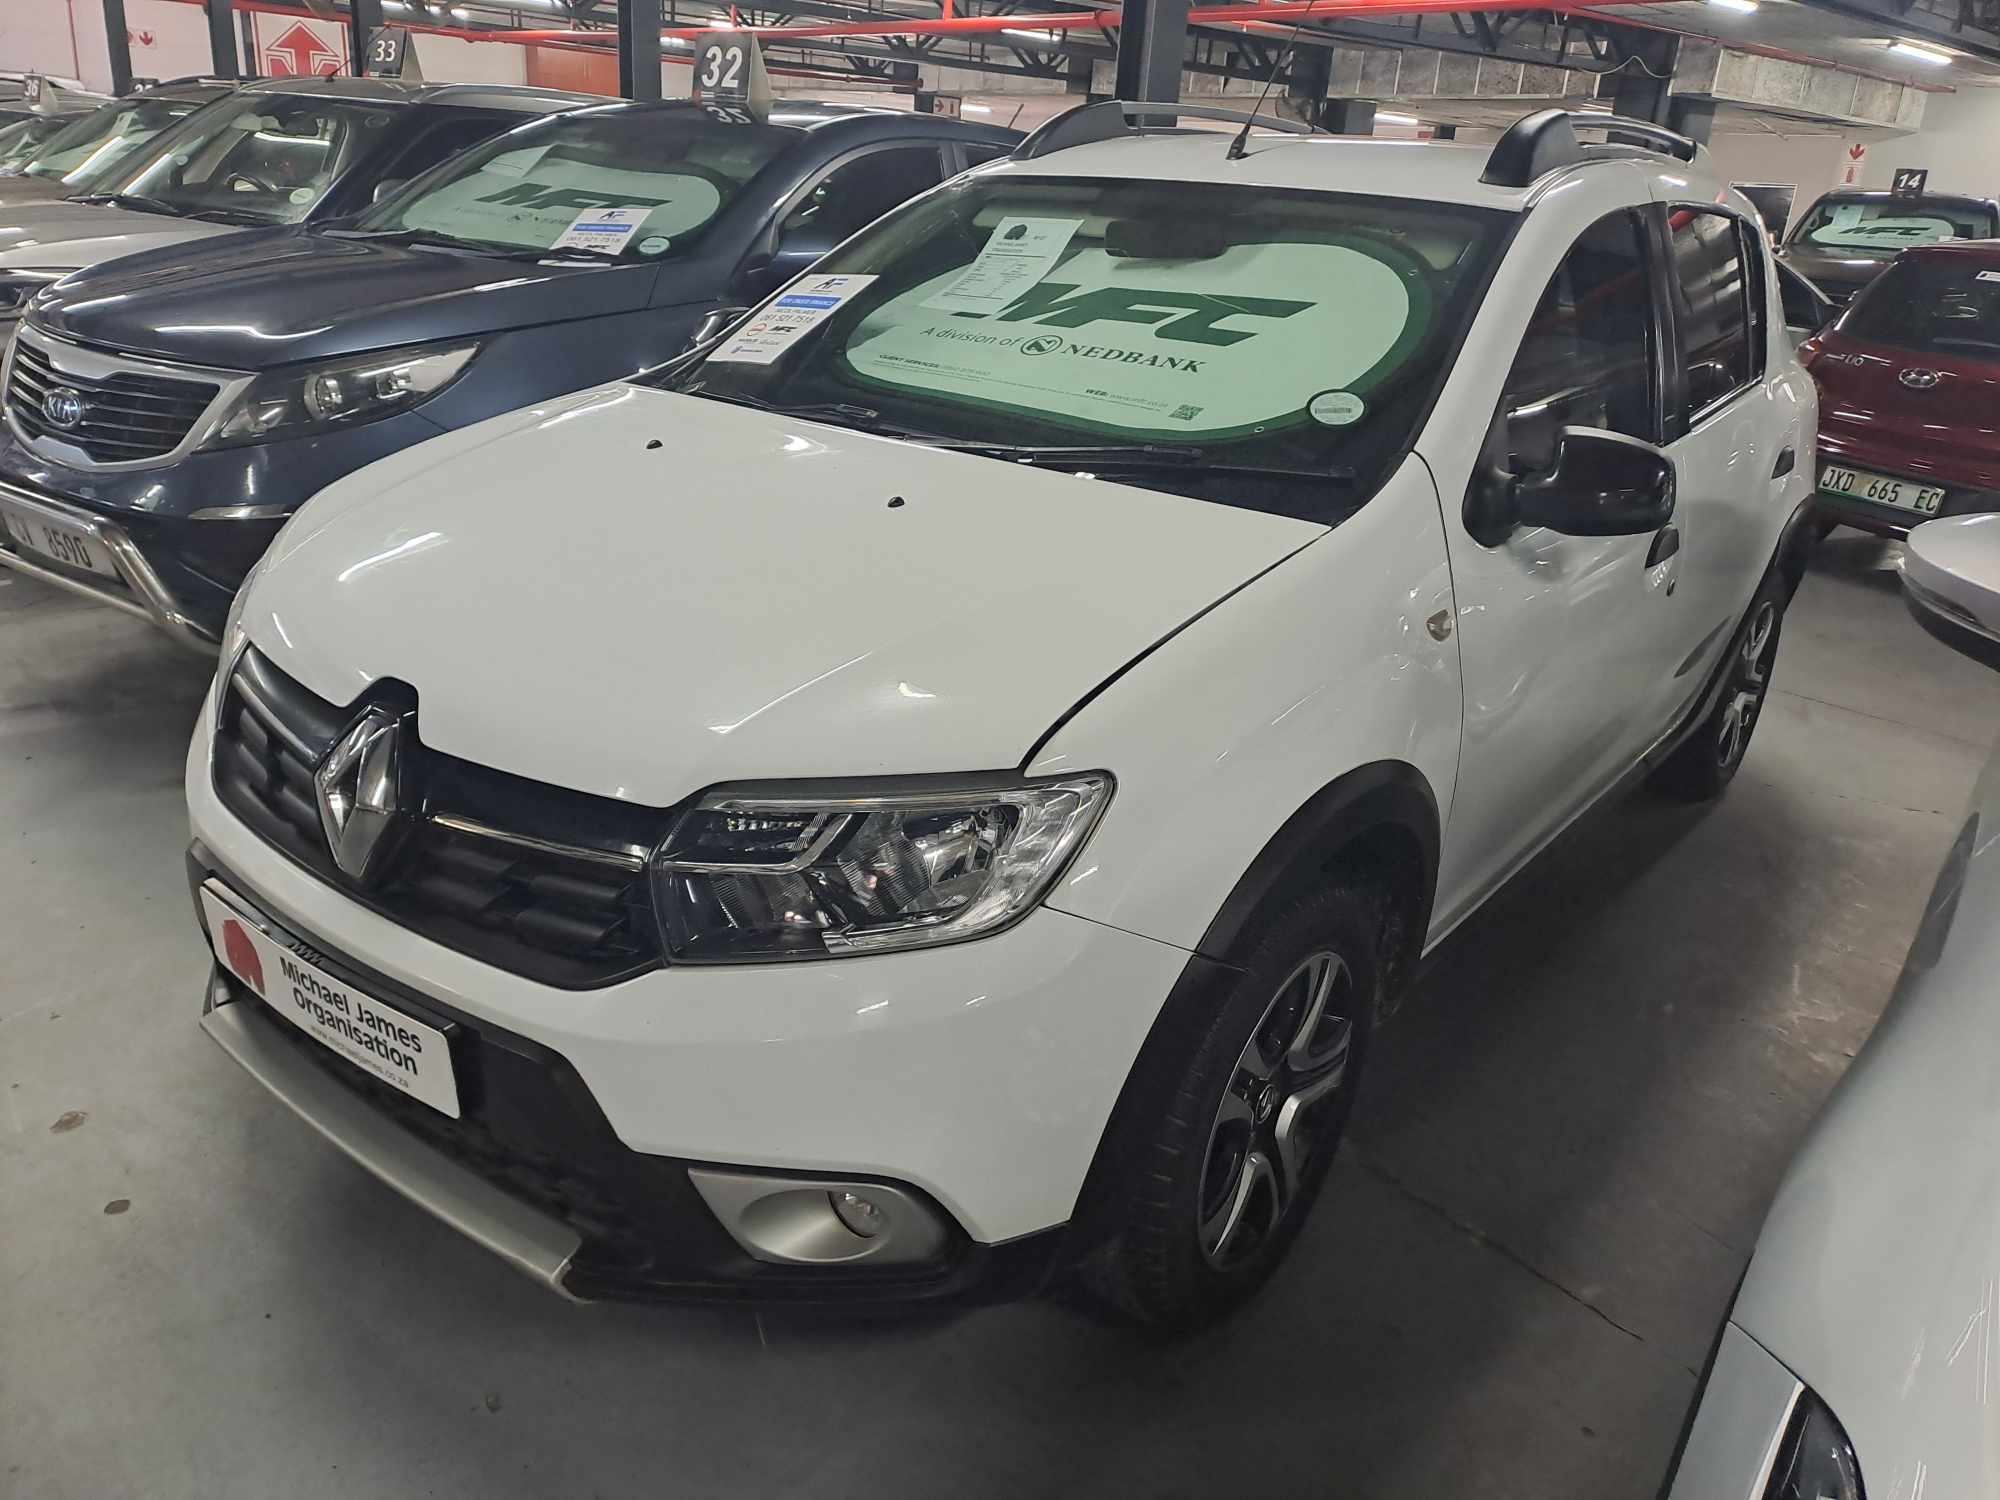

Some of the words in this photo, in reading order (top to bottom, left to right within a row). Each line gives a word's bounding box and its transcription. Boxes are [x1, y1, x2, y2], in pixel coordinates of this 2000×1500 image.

[375, 39, 396, 63] 33
[701, 45, 743, 88] 32
[24, 80, 39, 98] 36
[1899, 173, 1922, 189] 14
[1837, 225, 1931, 236] MFC
[920, 327, 935, 336] A
[936, 328, 998, 345] division
[999, 336, 1025, 347] of
[1061, 344, 1207, 373] NEDBANK
[49, 395, 77, 421] KIA
[1822, 468, 1856, 492] JXD
[1867, 479, 1903, 503] 665
[1913, 488, 1942, 512] EC
[280, 956, 349, 1014] Michael
[355, 1002, 422, 1054] James
[293, 989, 418, 1076] Organisation
